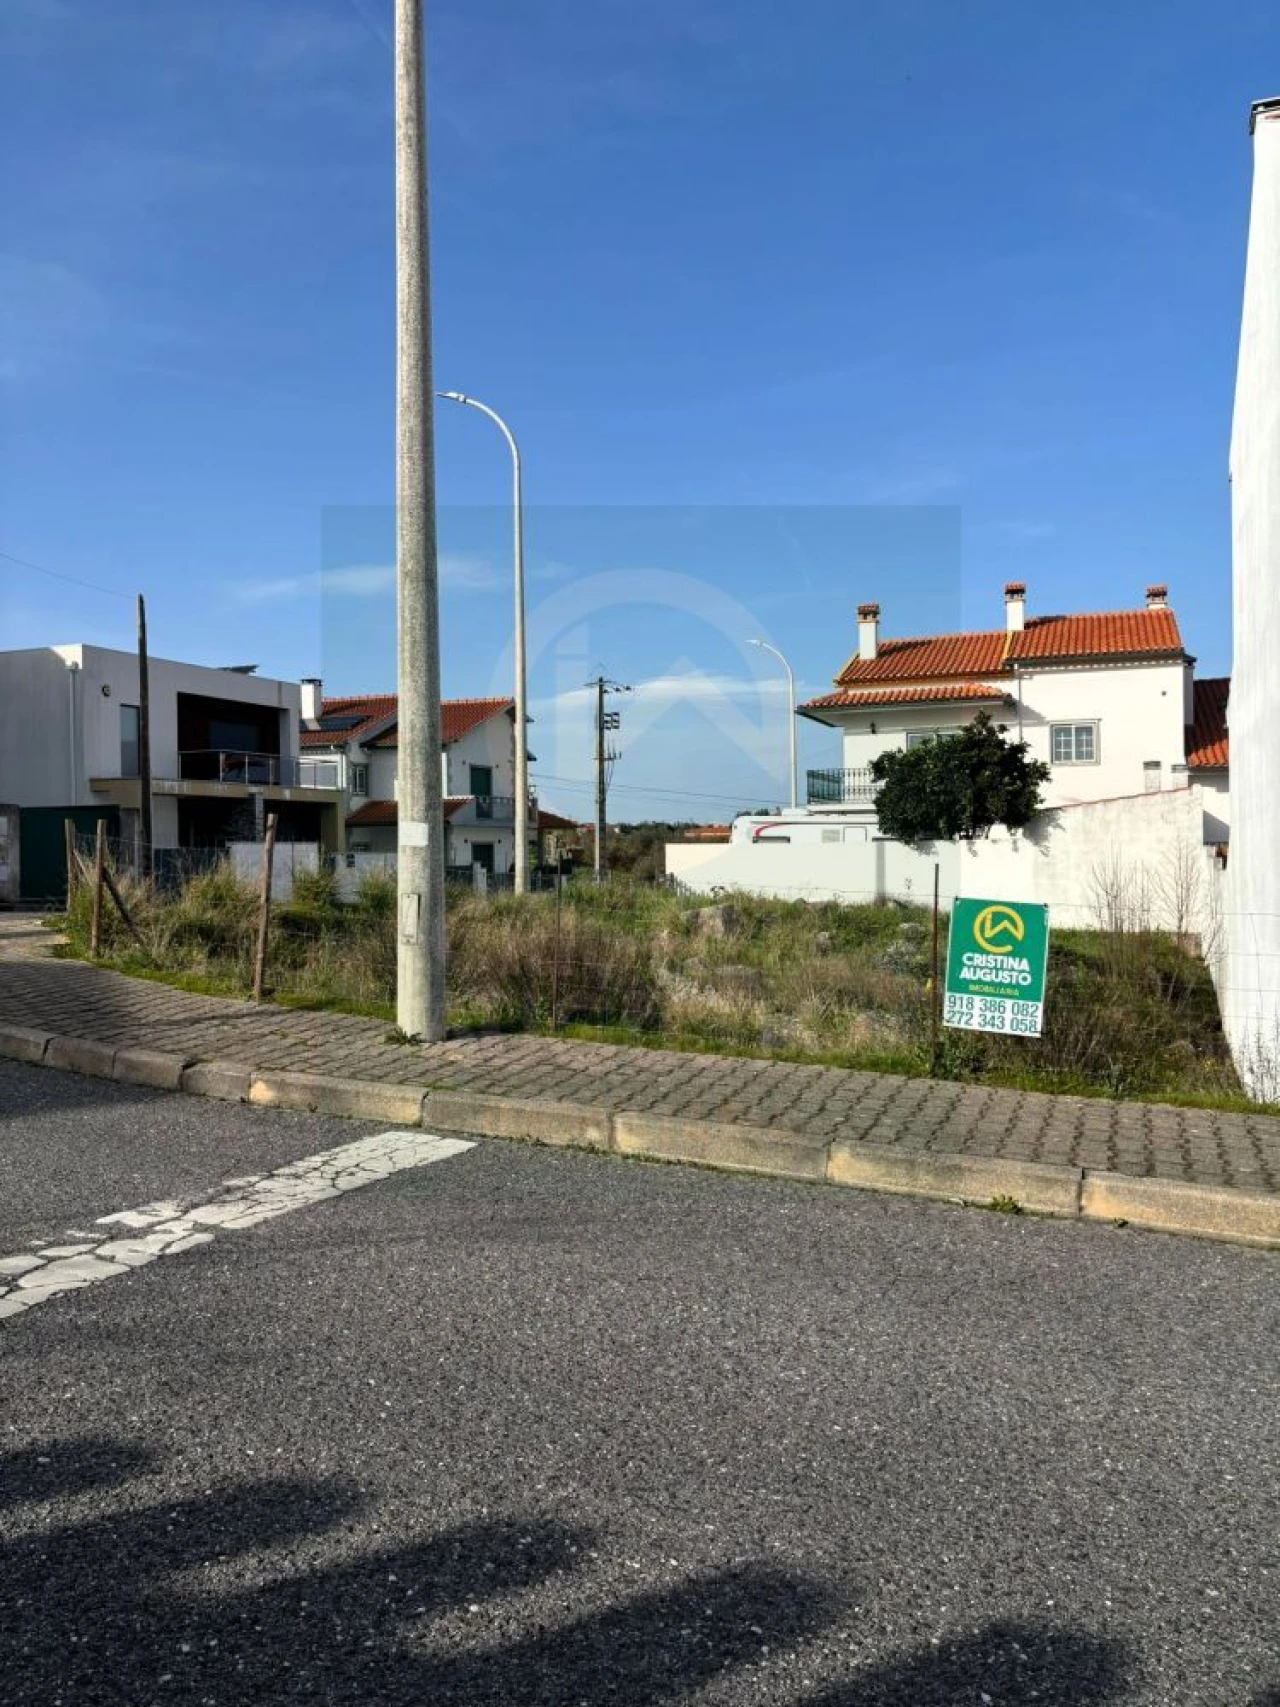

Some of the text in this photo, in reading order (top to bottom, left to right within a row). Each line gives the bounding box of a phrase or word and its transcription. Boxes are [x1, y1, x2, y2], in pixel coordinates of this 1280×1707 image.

[962, 952, 1029, 971] CRISTINA
[959, 966, 1032, 985] AUGUSTO
[948, 995, 1039, 1018] 918 386 082
[946, 1010, 1038, 1033] 272 343 058
